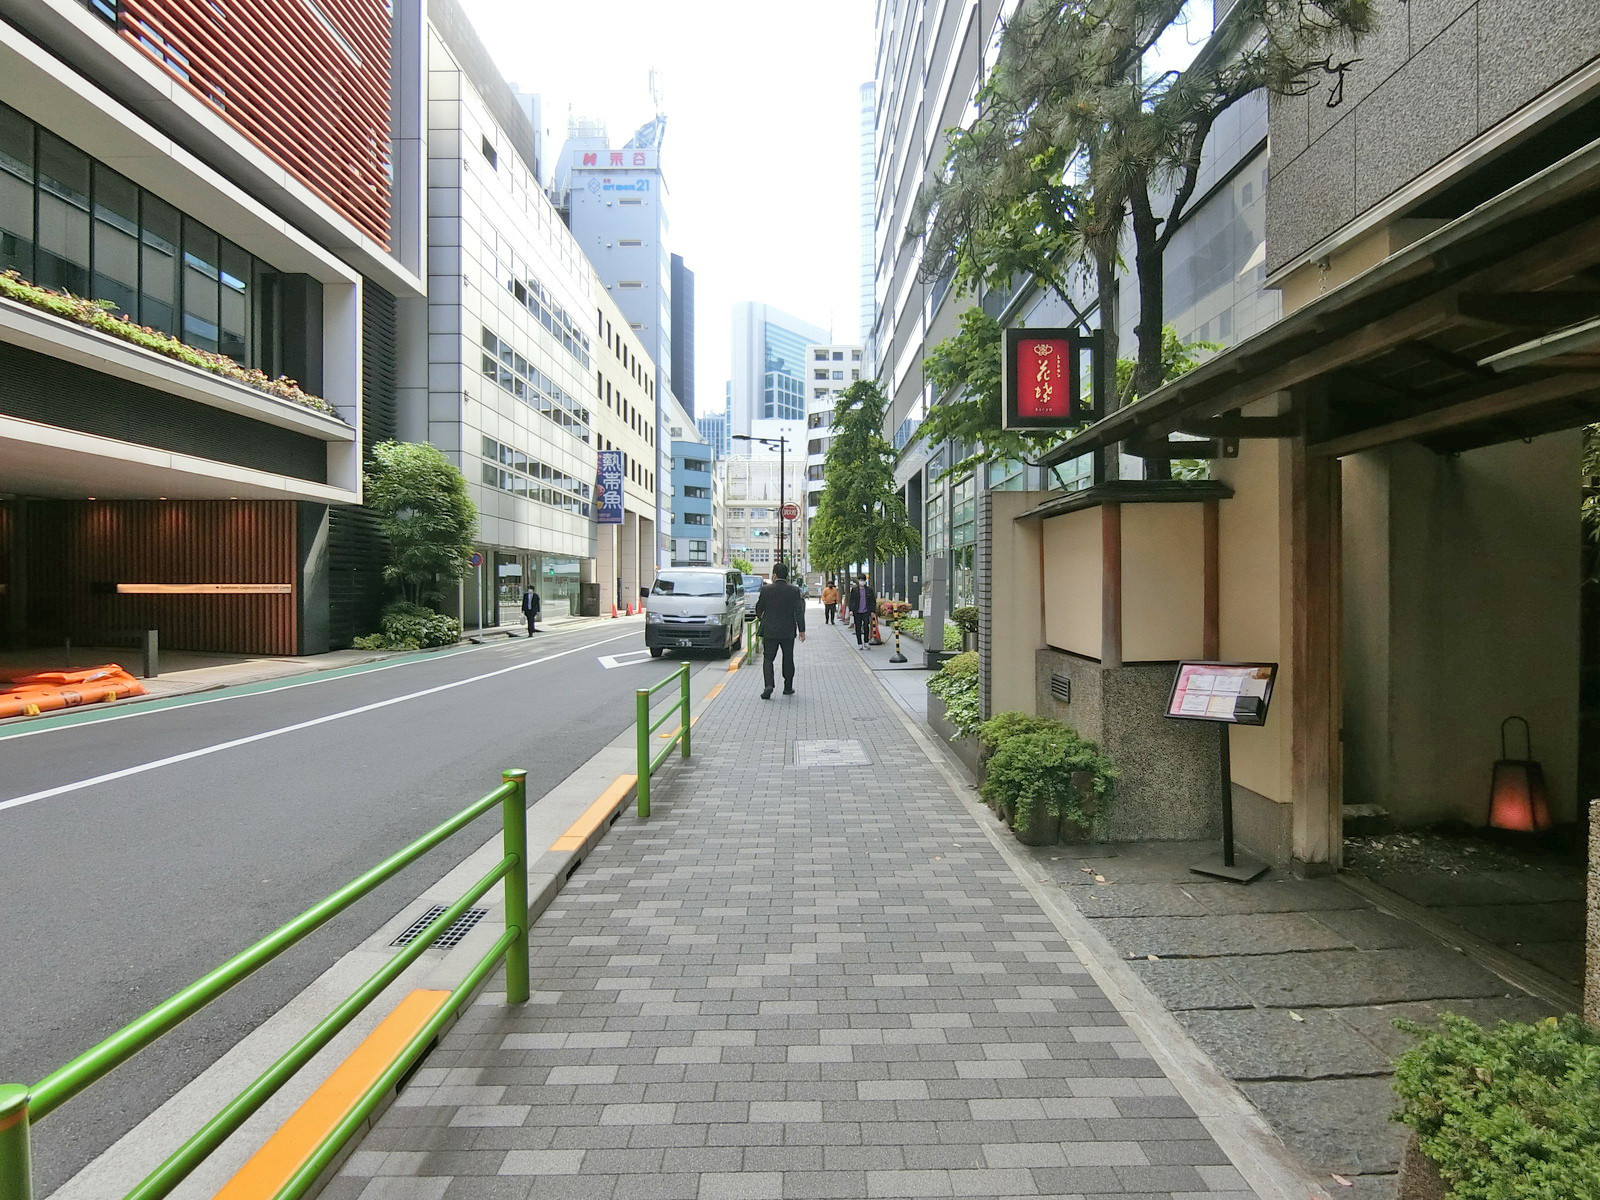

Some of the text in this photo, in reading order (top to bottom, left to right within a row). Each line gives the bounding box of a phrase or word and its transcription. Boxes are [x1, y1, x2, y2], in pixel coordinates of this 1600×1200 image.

[637, 179, 650, 191] 21
[603, 452, 621, 509] 熱帯魚
